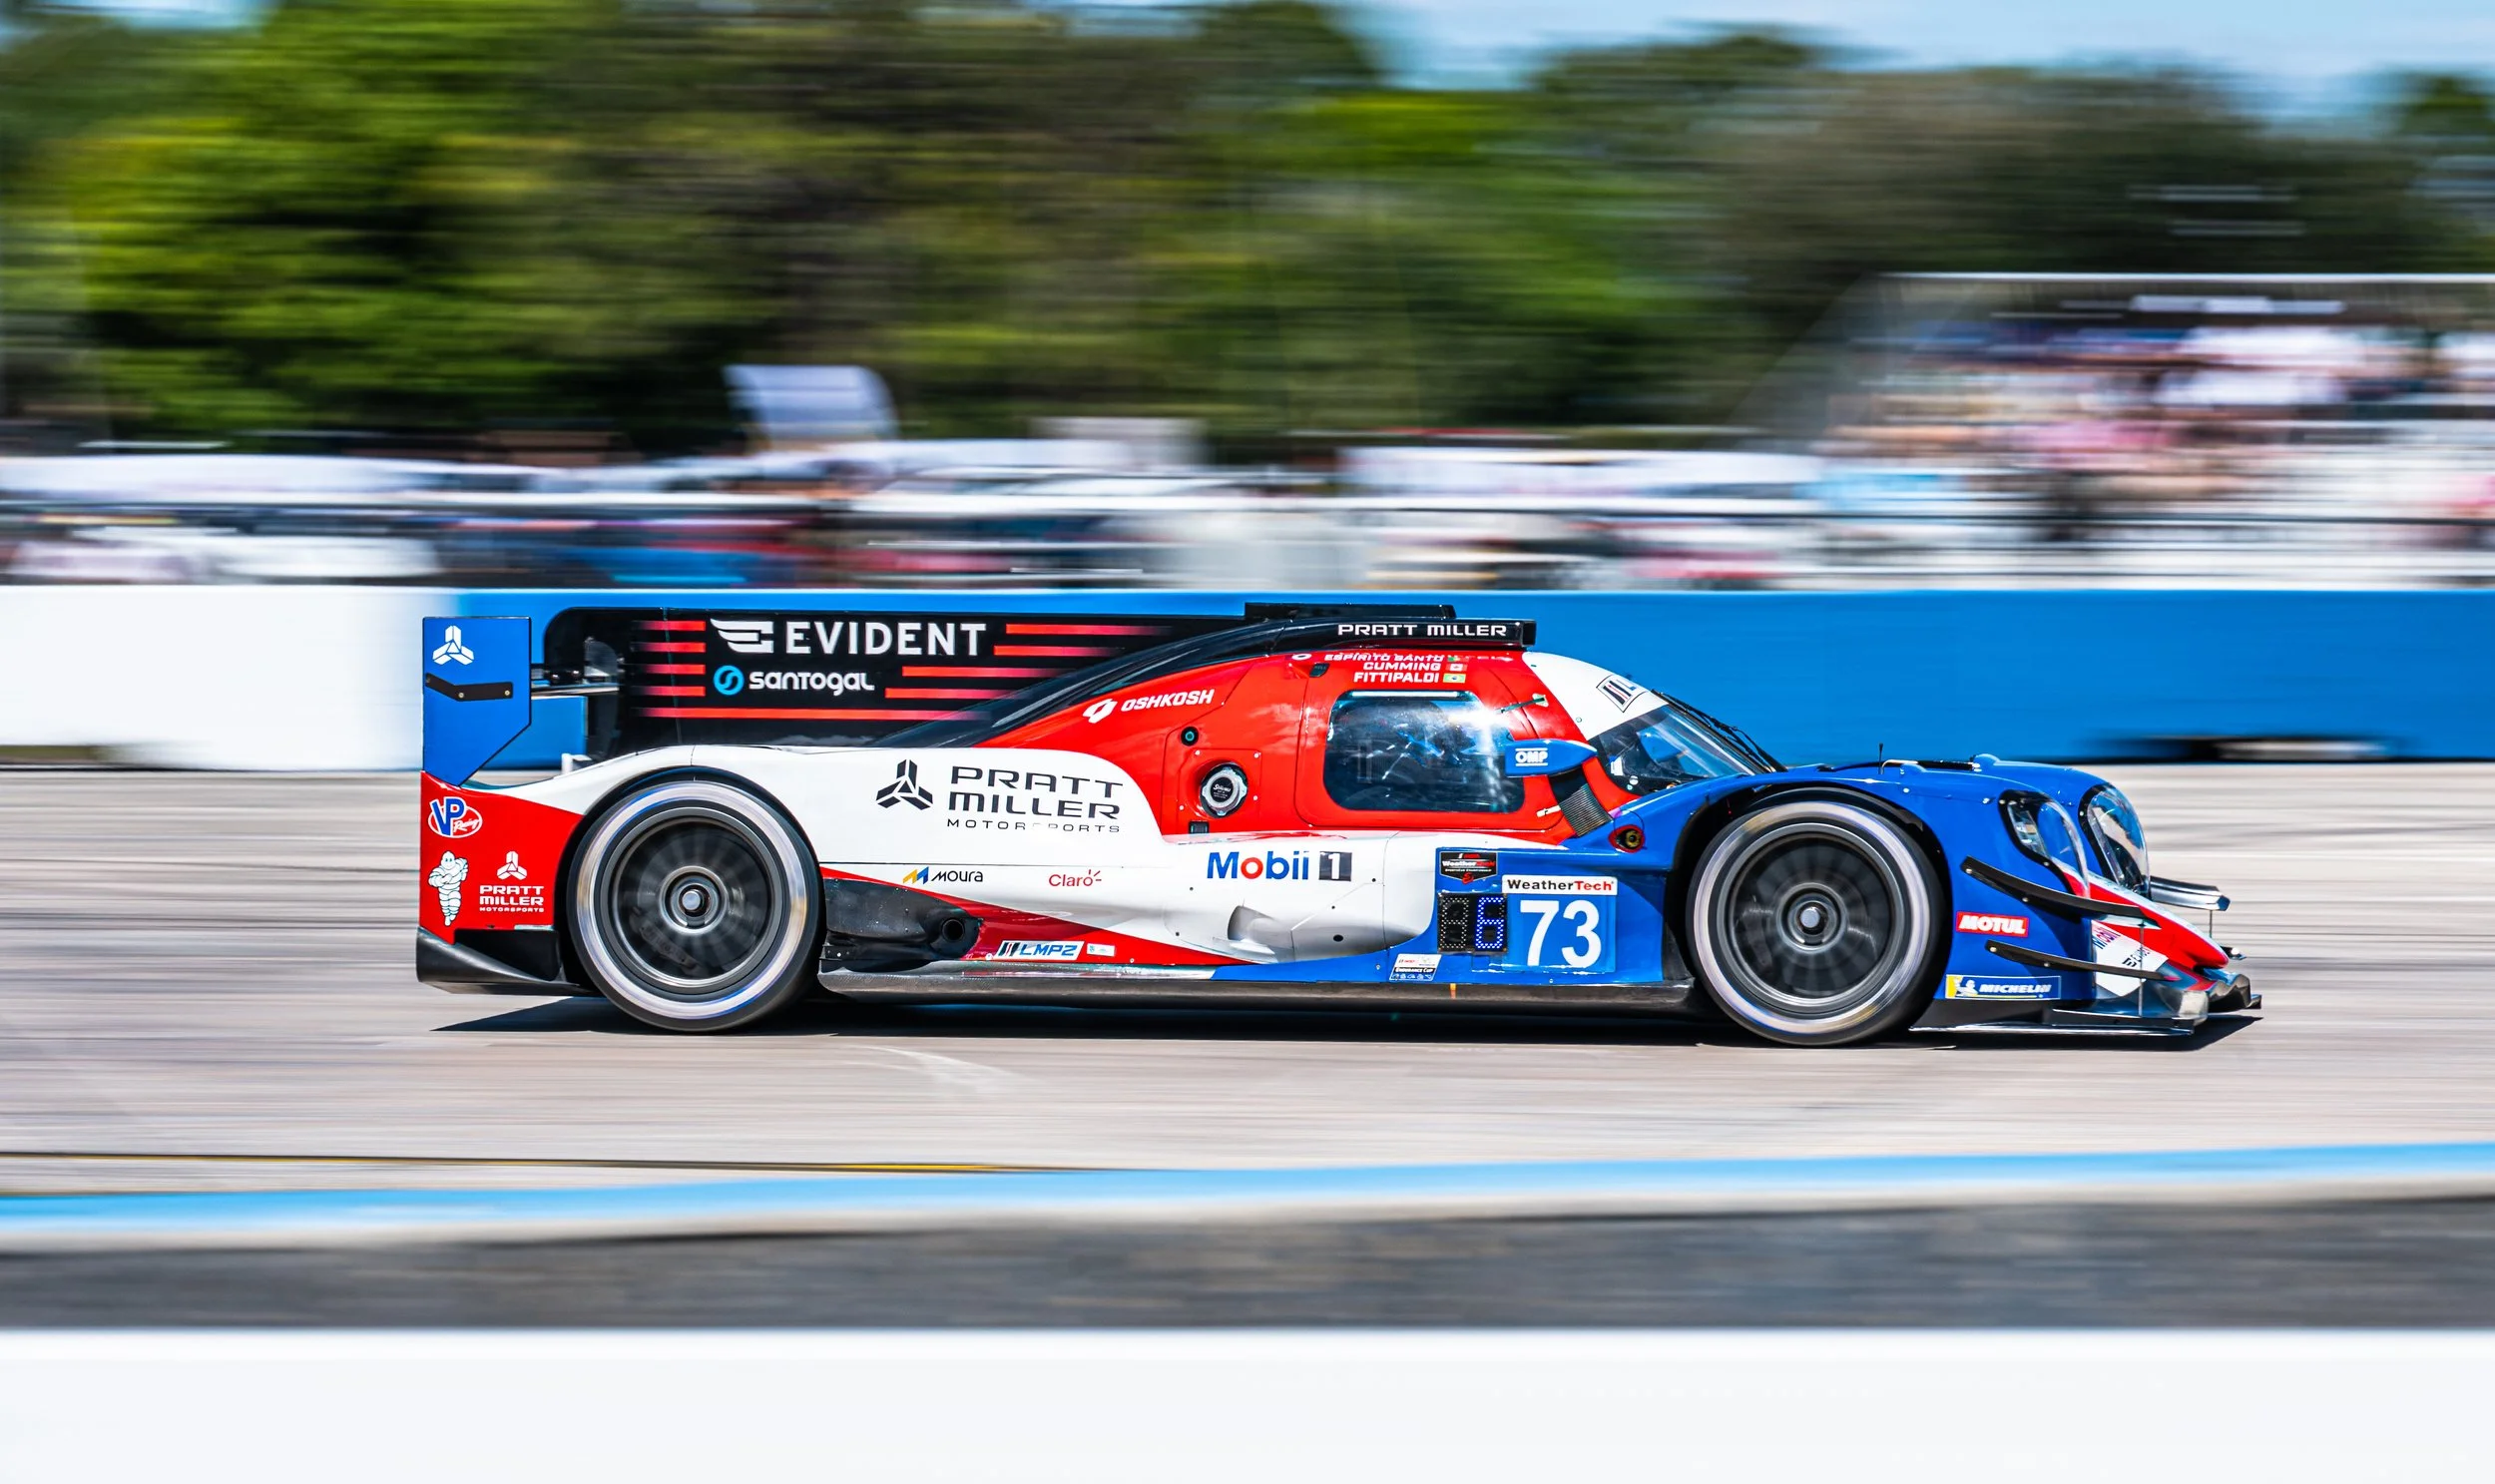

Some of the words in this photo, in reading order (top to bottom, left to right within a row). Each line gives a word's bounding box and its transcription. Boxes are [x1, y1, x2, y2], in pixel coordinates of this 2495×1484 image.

[1337, 624, 1417, 637] PRATT
[1426, 624, 1507, 637] MILLER
[786, 621, 987, 657] EVIDENT
[1363, 662, 1442, 672] CUMMING
[1353, 672, 1439, 683] FITTIPALDI
[1121, 689, 1215, 712] OSHKOSH
[1515, 750, 1548, 763] OMP
[950, 765, 1124, 798] PRATT
[948, 791, 1121, 819] MILLER
[430, 796, 466, 836] VP
[947, 818, 1120, 833] MOTORPORTS
[1048, 871, 1097, 887] Claro
[1507, 878, 1614, 891] WeatherTech
[479, 885, 545, 895] PRATT
[479, 895, 544, 906] MILLER
[1958, 914, 2026, 934] MOTUL
[1520, 899, 1602, 969] 73
[1019, 944, 1078, 956] LMP2
[1979, 984, 2052, 994] MICHELIN
